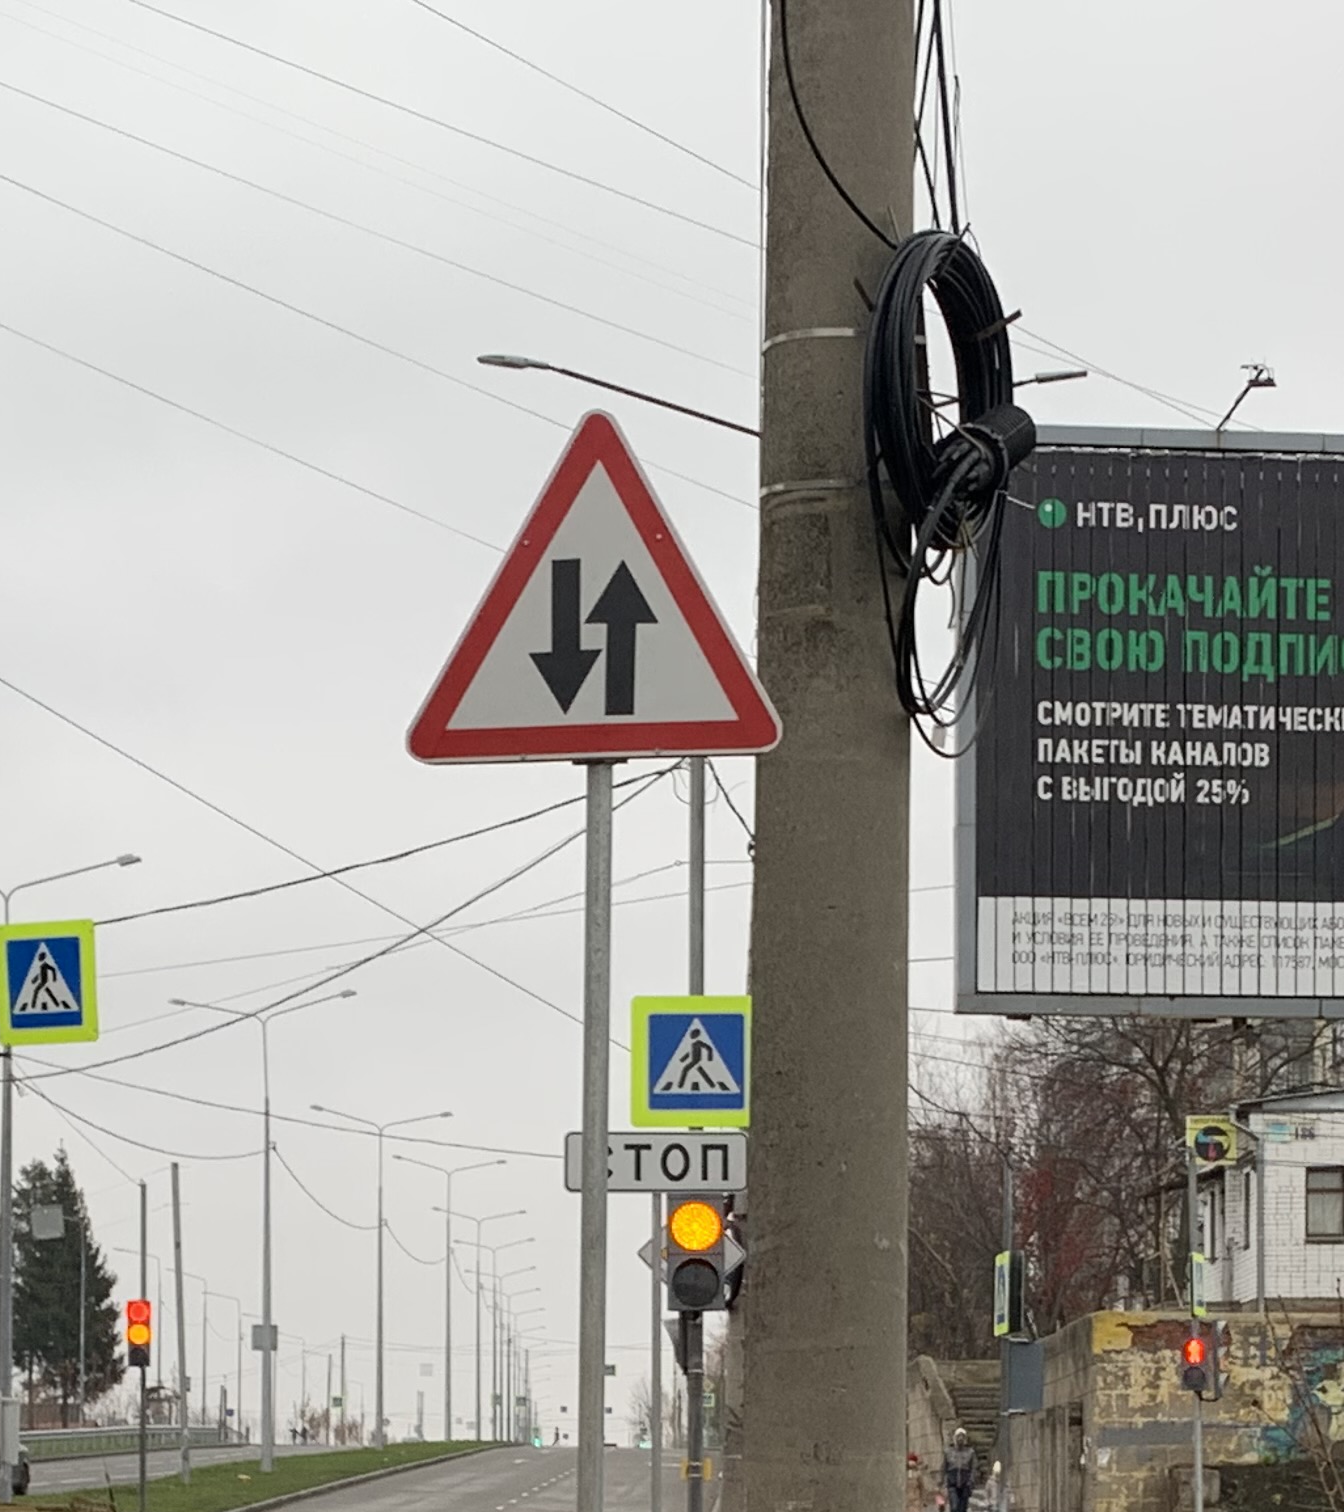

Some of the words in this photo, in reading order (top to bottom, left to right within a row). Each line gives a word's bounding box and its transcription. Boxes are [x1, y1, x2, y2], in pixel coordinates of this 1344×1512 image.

[1036, 565, 1332, 622] ПРОКАЧАЙТЕ
[1036, 626, 1165, 673] СВОЮ
[1037, 700, 1171, 729] СМОТРИТЕ
[1037, 738, 1142, 766] ПАКЕТЫ
[1150, 741, 1270, 768] КАНАЛОВ
[1037, 776, 1053, 800] С
[1061, 772, 1186, 808] ВЫГОДОЙ
[1196, 778, 1251, 805] 25%
[605, 1143, 730, 1182] ТОП
